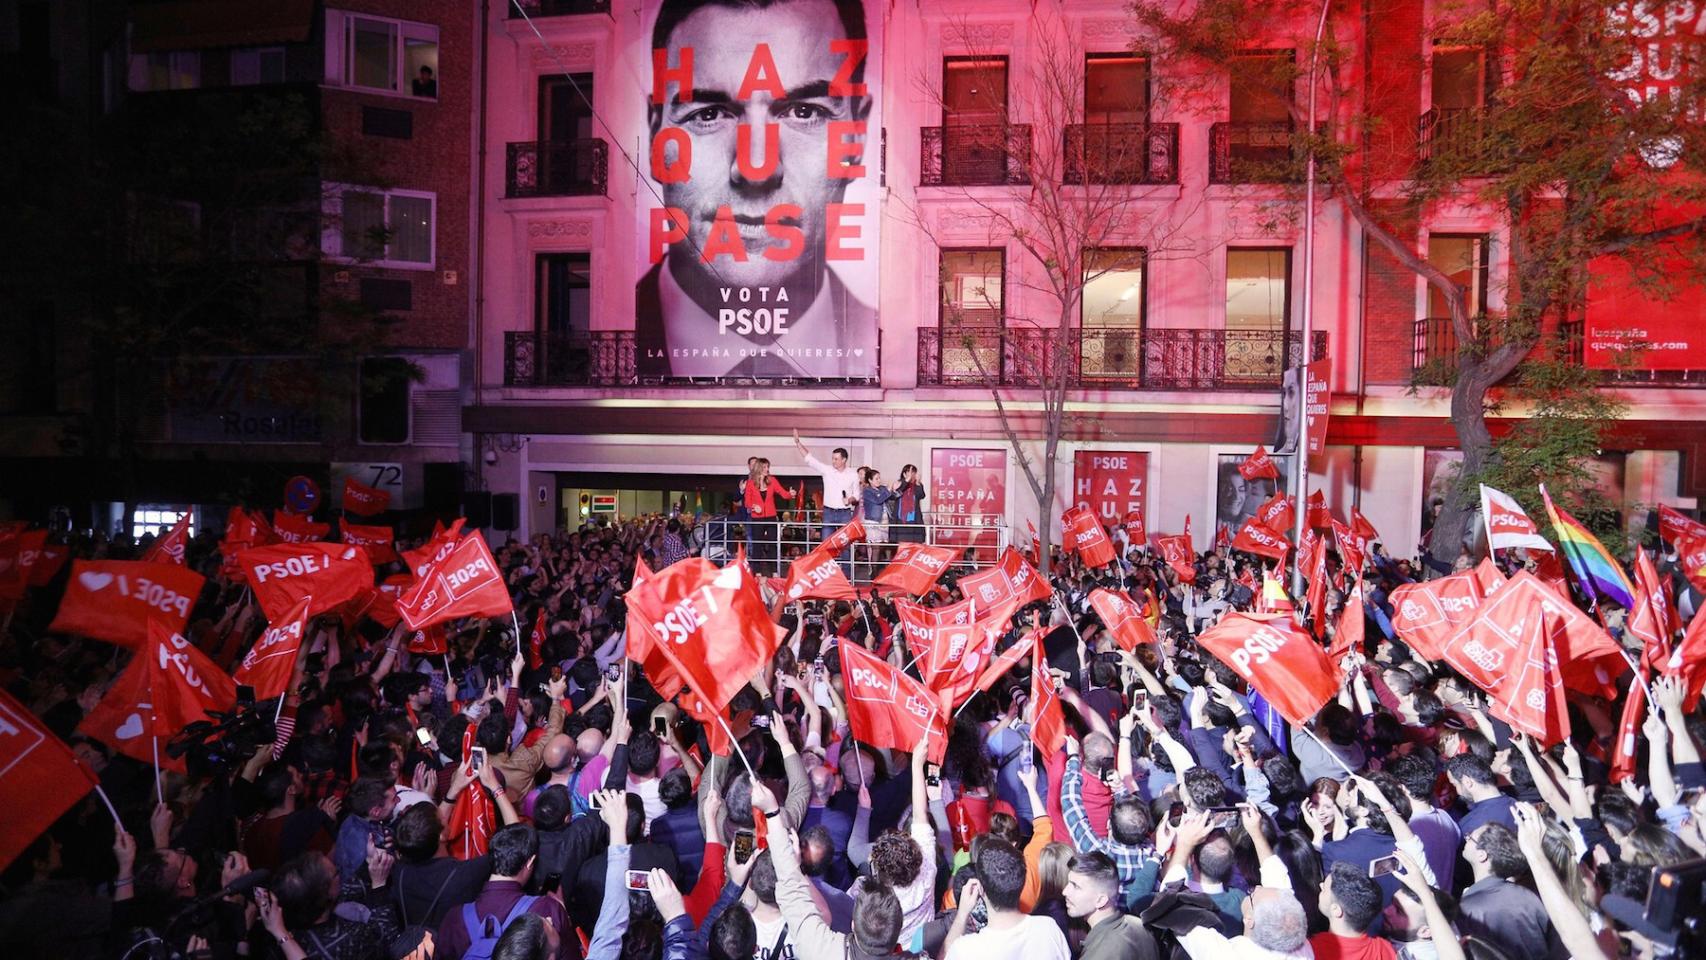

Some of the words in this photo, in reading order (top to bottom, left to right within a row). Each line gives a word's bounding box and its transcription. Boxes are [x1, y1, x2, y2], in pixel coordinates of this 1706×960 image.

[652, 39, 868, 105] HAZ
[652, 121, 867, 184] QUE
[649, 203, 865, 263] PASE
[720, 287, 789, 302] VOTA
[718, 308, 789, 335] PSOE
[648, 349, 664, 357] LA
[673, 347, 730, 357] ESPAÑA
[1309, 372, 1315, 382] LA
[949, 455, 984, 467] PSOE
[1093, 457, 1128, 469] PSOE
[369, 465, 402, 489] 72
[938, 477, 955, 486] LA
[938, 489, 995, 500] ESPAÑA
[1078, 478, 1142, 496] HAZ
[1244, 525, 1272, 545] PSOE
[254, 555, 319, 583] PSOE
